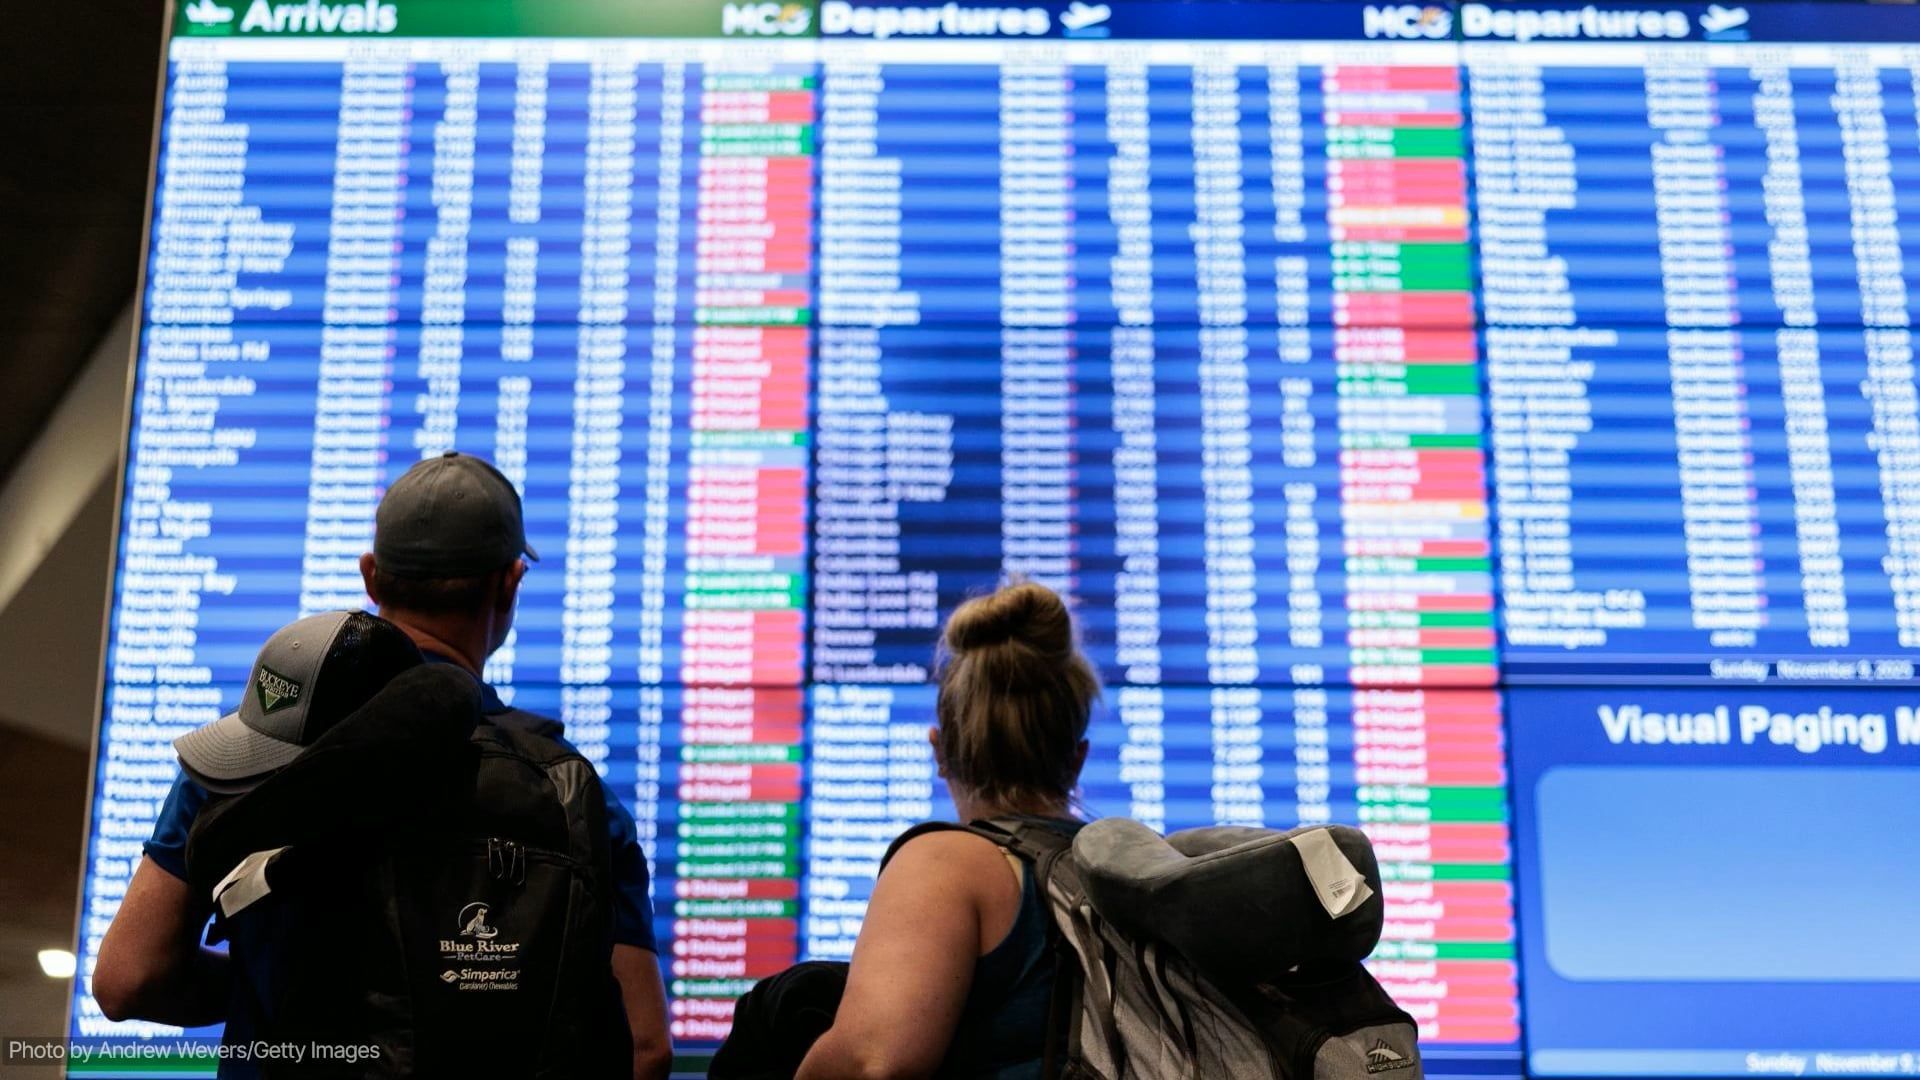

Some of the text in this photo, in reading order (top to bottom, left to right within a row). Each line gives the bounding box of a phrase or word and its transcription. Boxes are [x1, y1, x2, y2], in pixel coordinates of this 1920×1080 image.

[241, 0, 397, 32] Arrivals
[820, 1, 1050, 38] Departures
[1461, 4, 1690, 42] Departures
[1710, 659, 1769, 682] Sunday
[1777, 659, 1855, 682] November
[260, 667, 299, 698] BUCKEYE
[1598, 705, 1731, 745] Visual
[1739, 705, 1887, 753] Paging
[690, 879, 748, 899] Delayed
[689, 918, 746, 939] Delayed
[440, 940, 519, 952] Blue River
[457, 951, 501, 961] PetCare
[688, 938, 746, 958] Delayed
[687, 958, 745, 978] Delayed
[1746, 1052, 1807, 1076] Sunday
[1815, 1052, 1898, 1073] November
